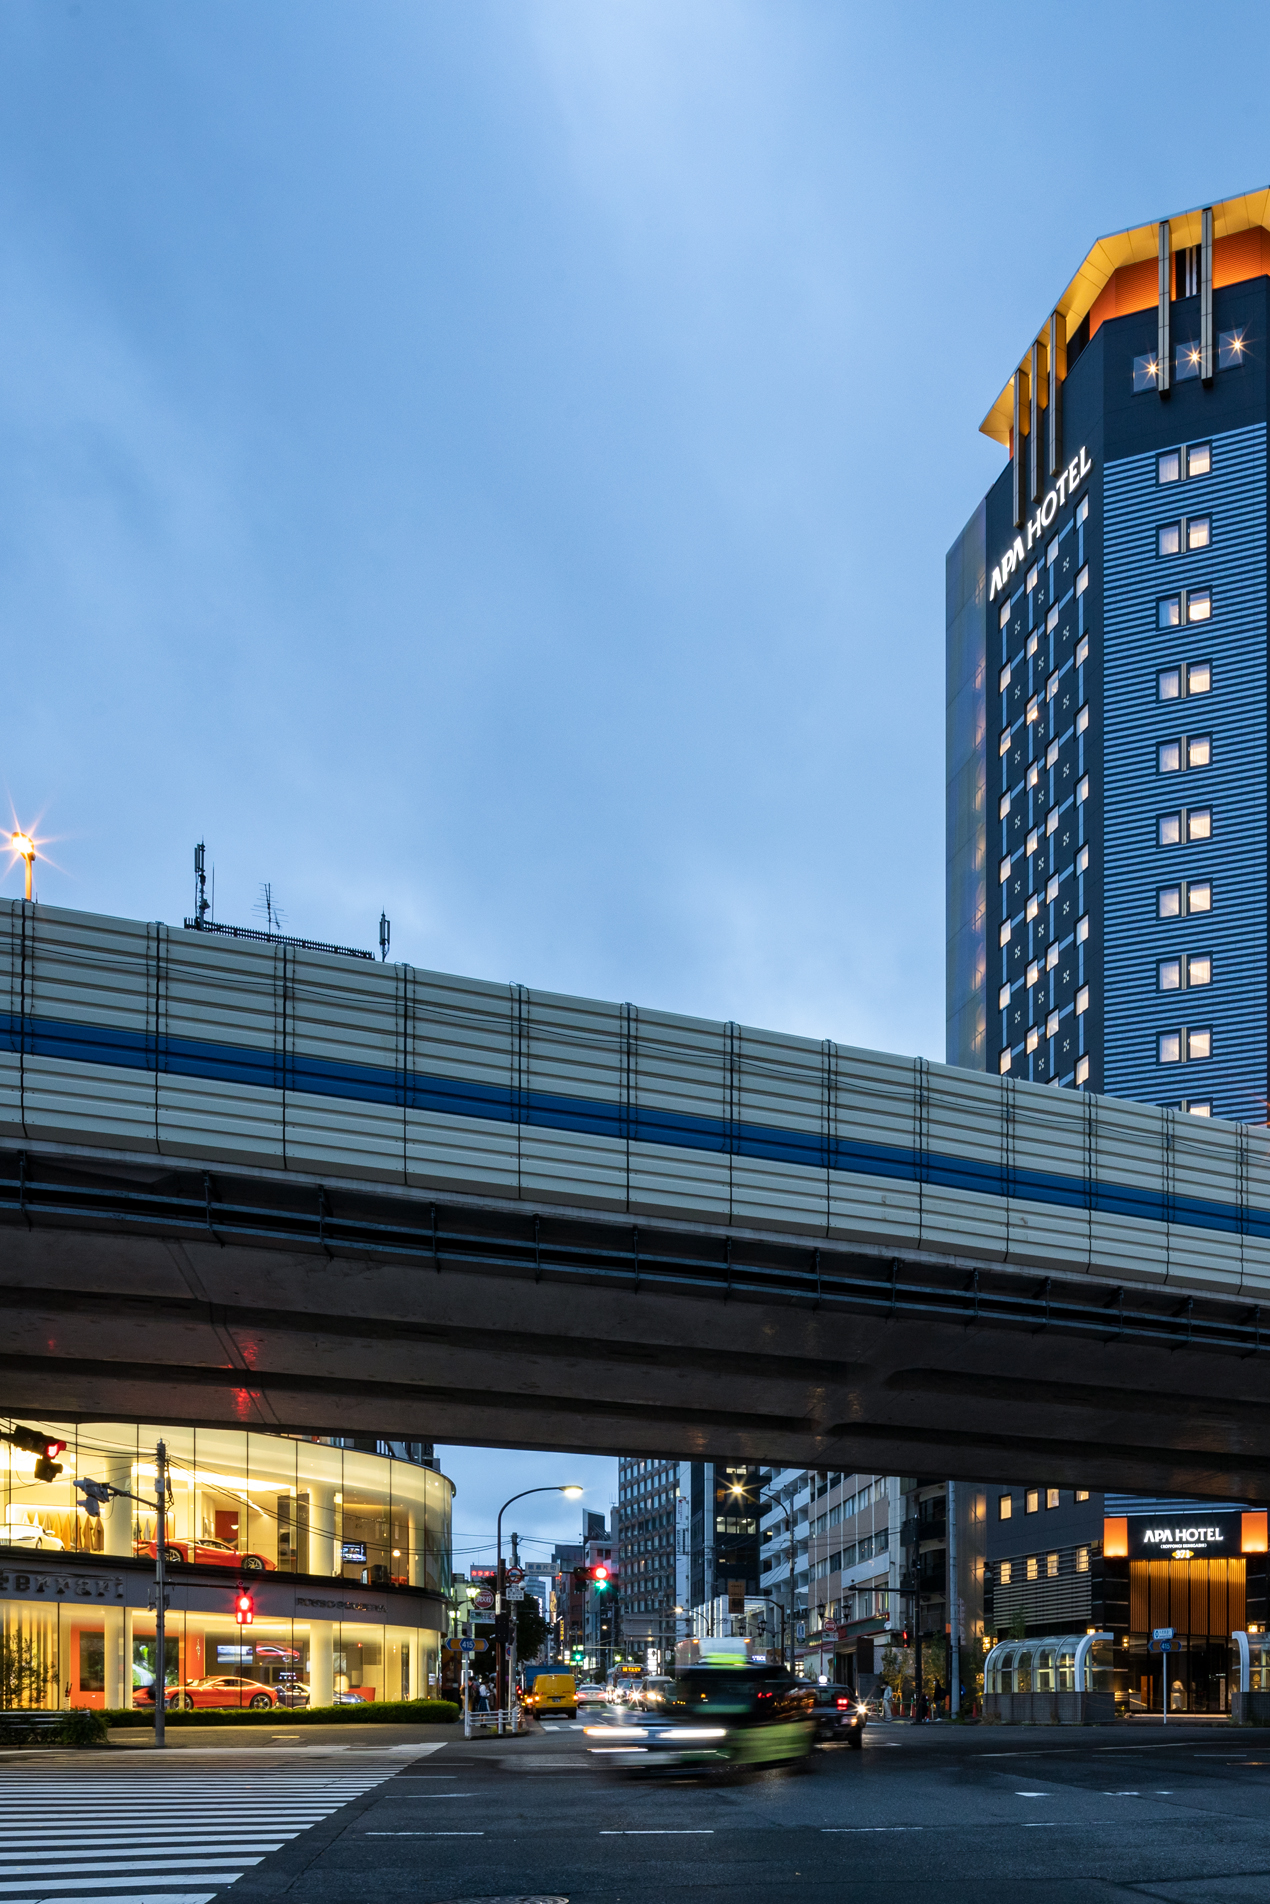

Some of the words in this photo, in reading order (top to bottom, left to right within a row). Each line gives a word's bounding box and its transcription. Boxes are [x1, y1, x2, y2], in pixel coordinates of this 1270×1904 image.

[989, 535, 1025, 602] APA
[1027, 446, 1092, 550] HOTEL
[1143, 1529, 1173, 1543] APA
[1175, 1527, 1224, 1541] HOTEL
[1175, 1549, 1190, 1559] 371
[461, 1641, 473, 1649] 415
